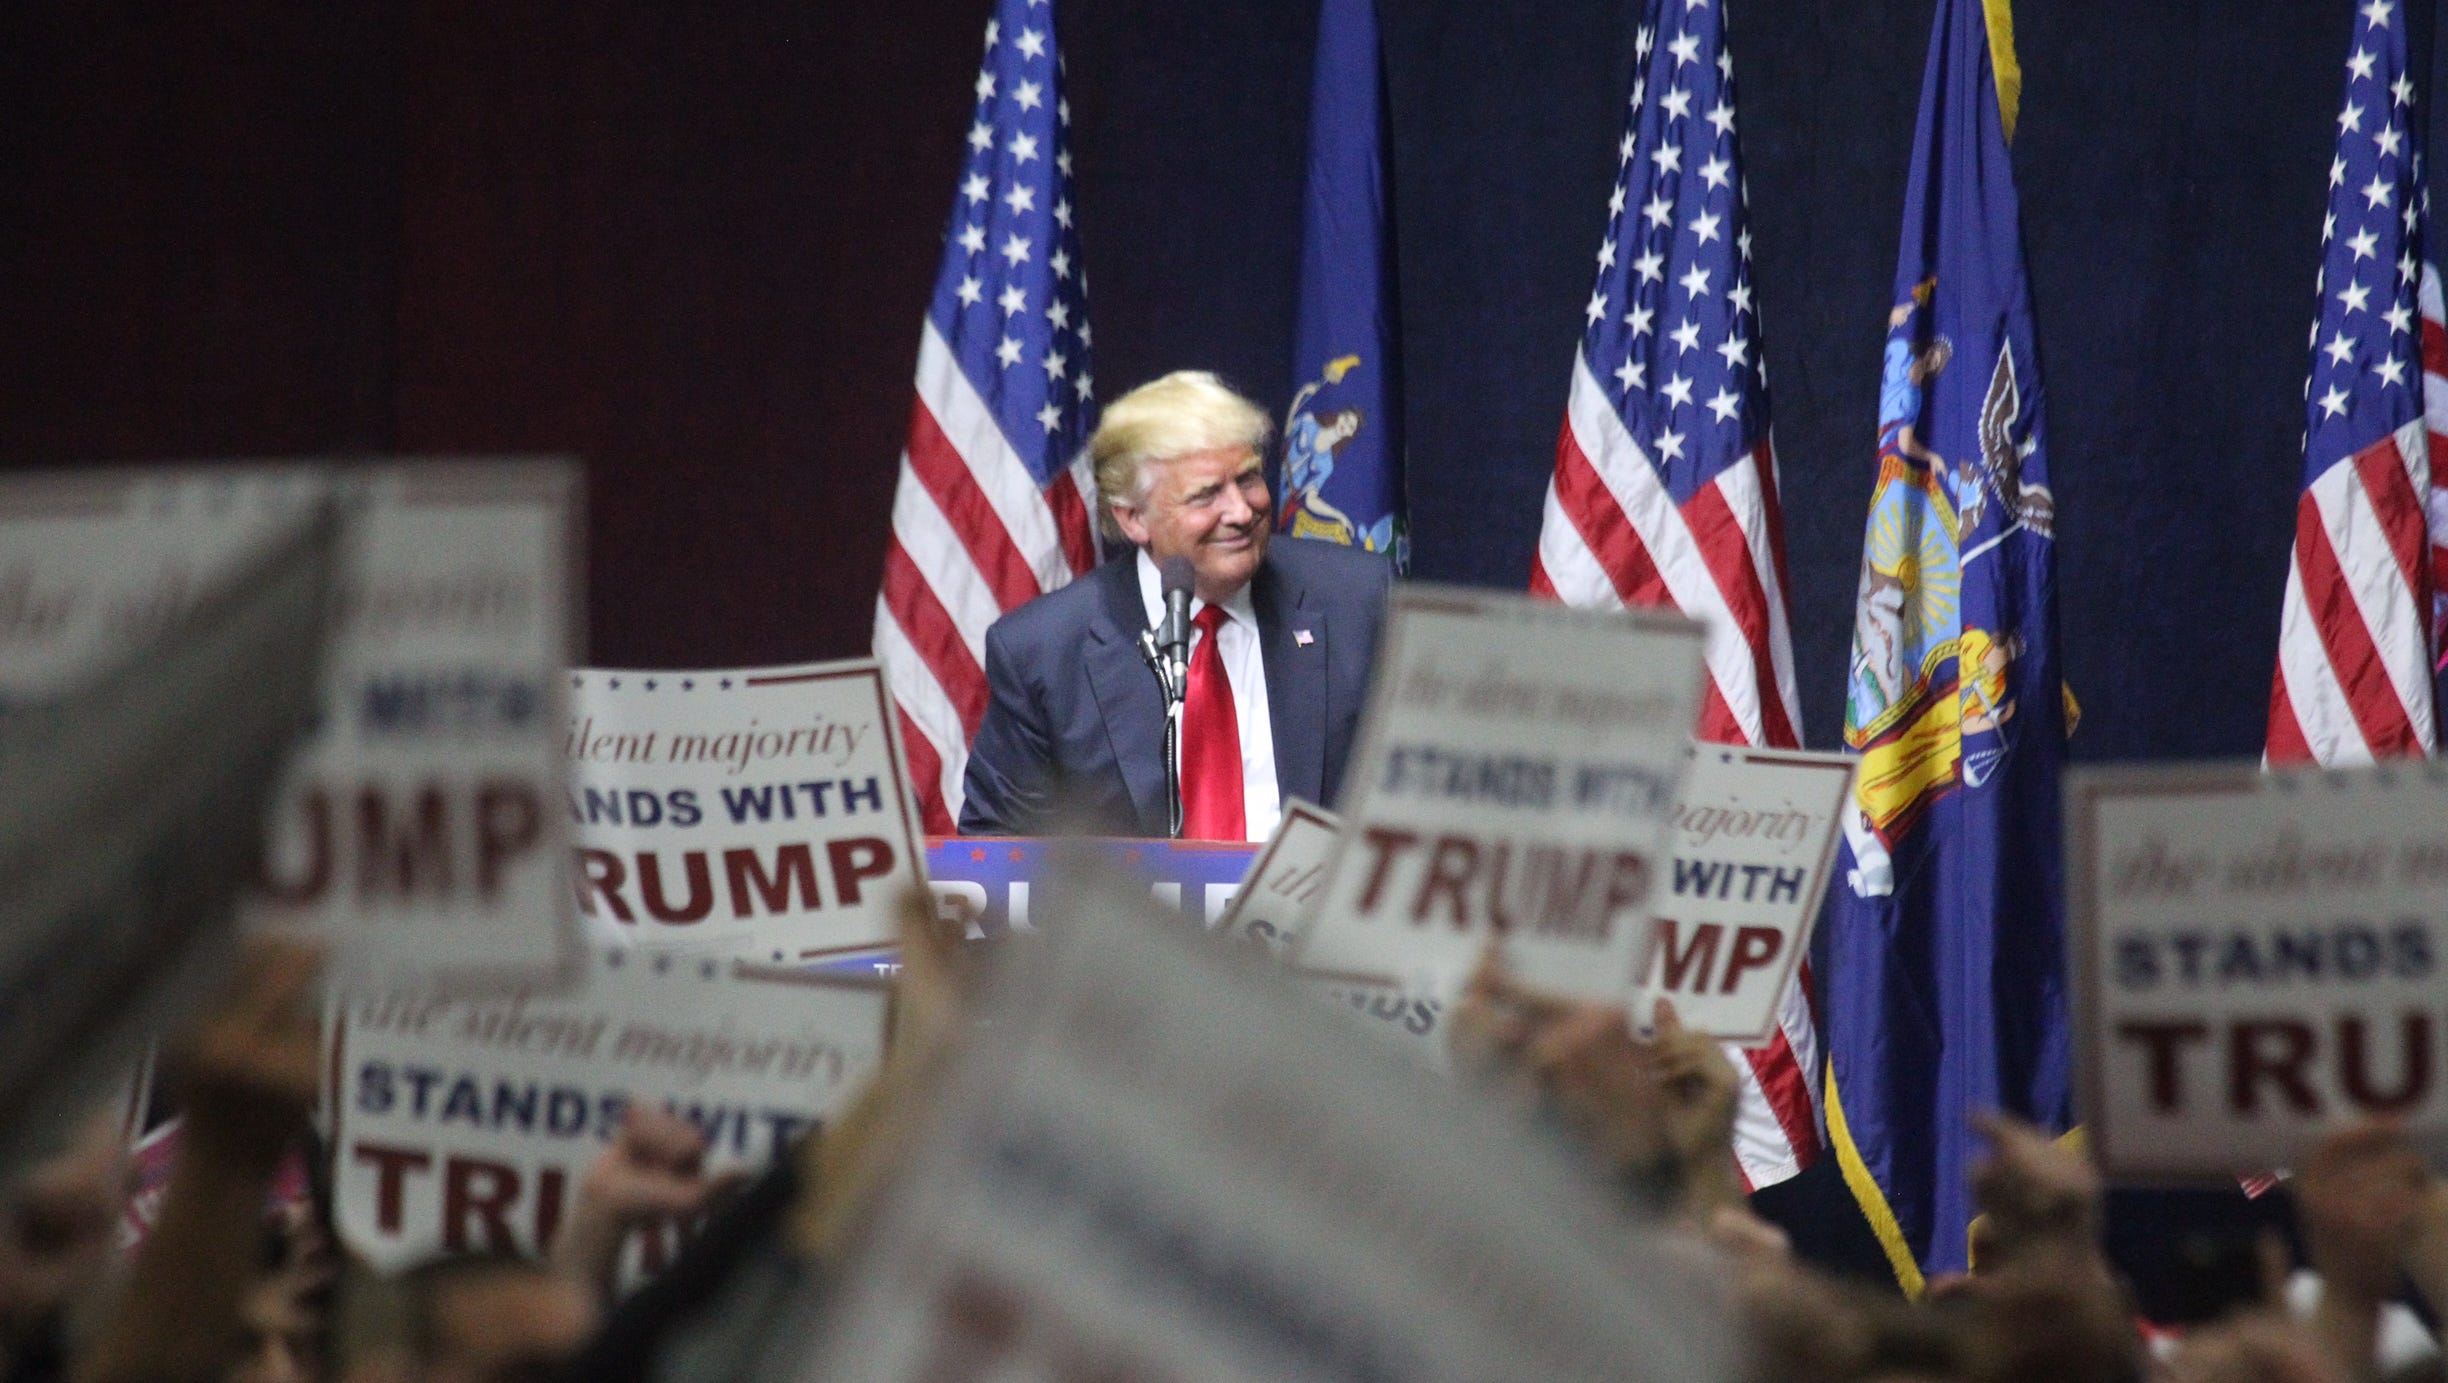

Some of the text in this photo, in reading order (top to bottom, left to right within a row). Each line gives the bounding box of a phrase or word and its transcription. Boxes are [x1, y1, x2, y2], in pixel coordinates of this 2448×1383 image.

[667, 716, 869, 775] majority
[720, 776, 883, 824] WITH
[571, 836, 898, 927] RUMP
[1354, 824, 1654, 944] TRUMP
[1671, 857, 1807, 905] WITH
[1634, 916, 1784, 996] MP
[2114, 914, 2440, 990] STANDS
[2116, 1010, 2436, 1118] TRU
